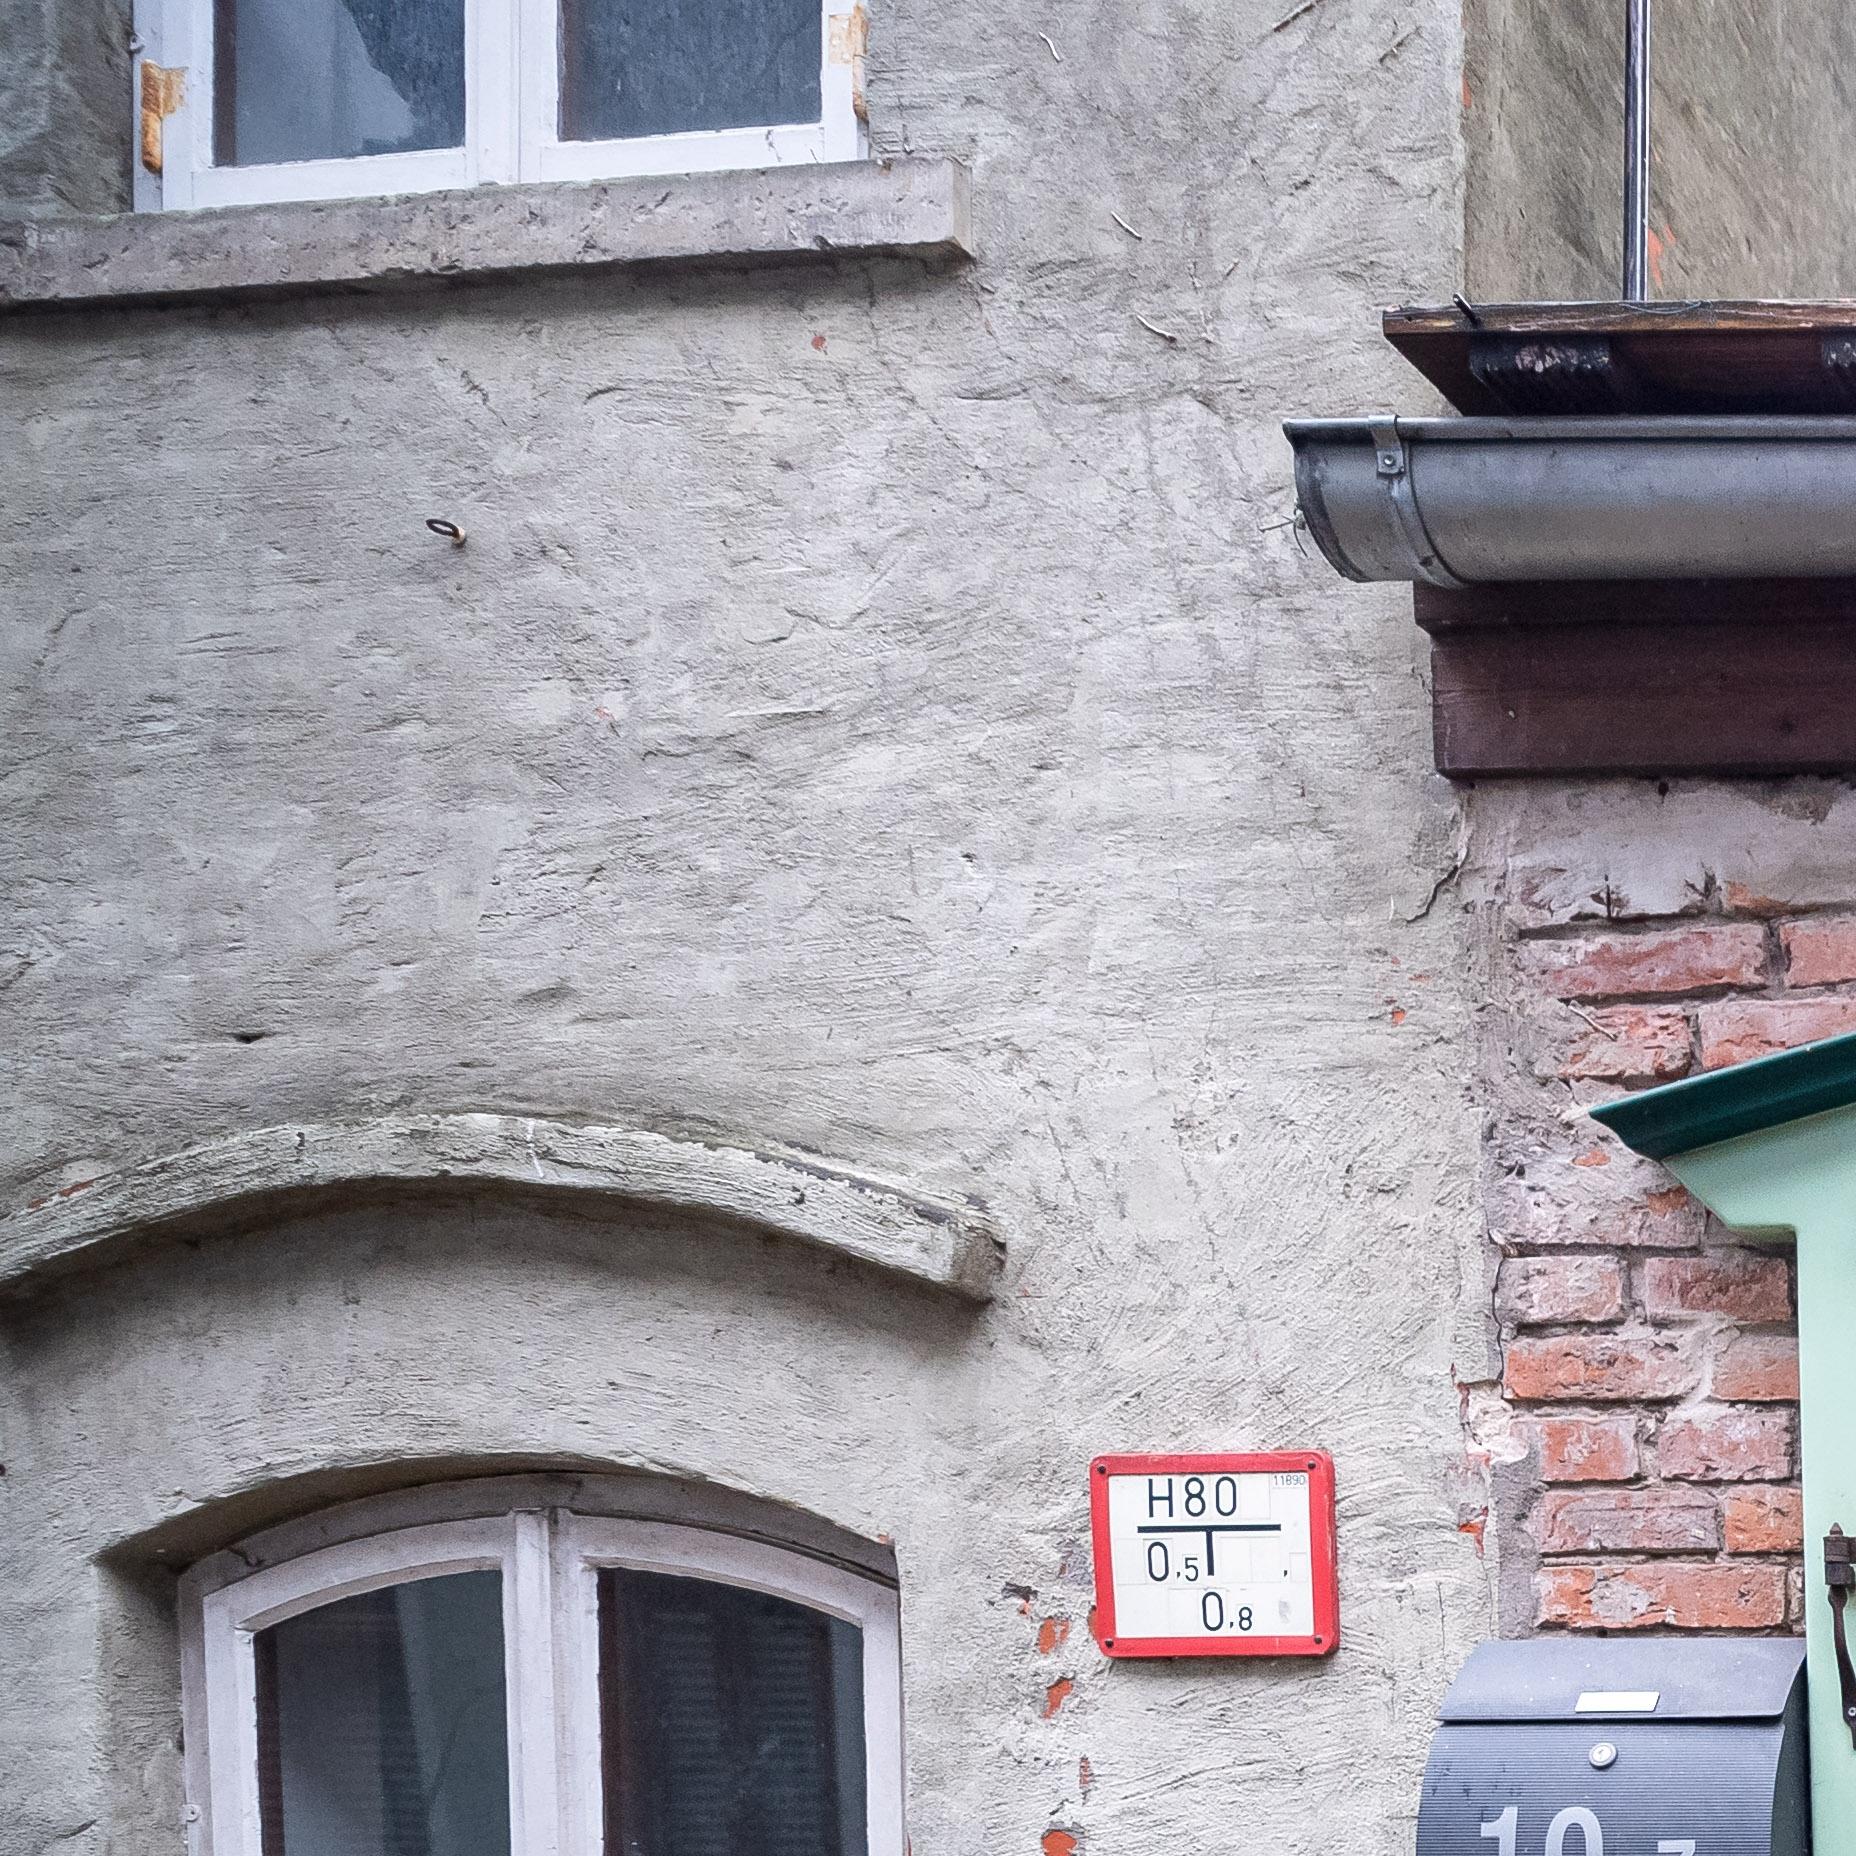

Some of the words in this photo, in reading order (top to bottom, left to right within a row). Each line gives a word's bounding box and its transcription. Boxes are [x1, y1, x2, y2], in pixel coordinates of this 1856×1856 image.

[1148, 1476, 1237, 1518] H80
[1147, 1541, 1199, 1582] 0,5
[1202, 1591, 1253, 1632] 0,8
